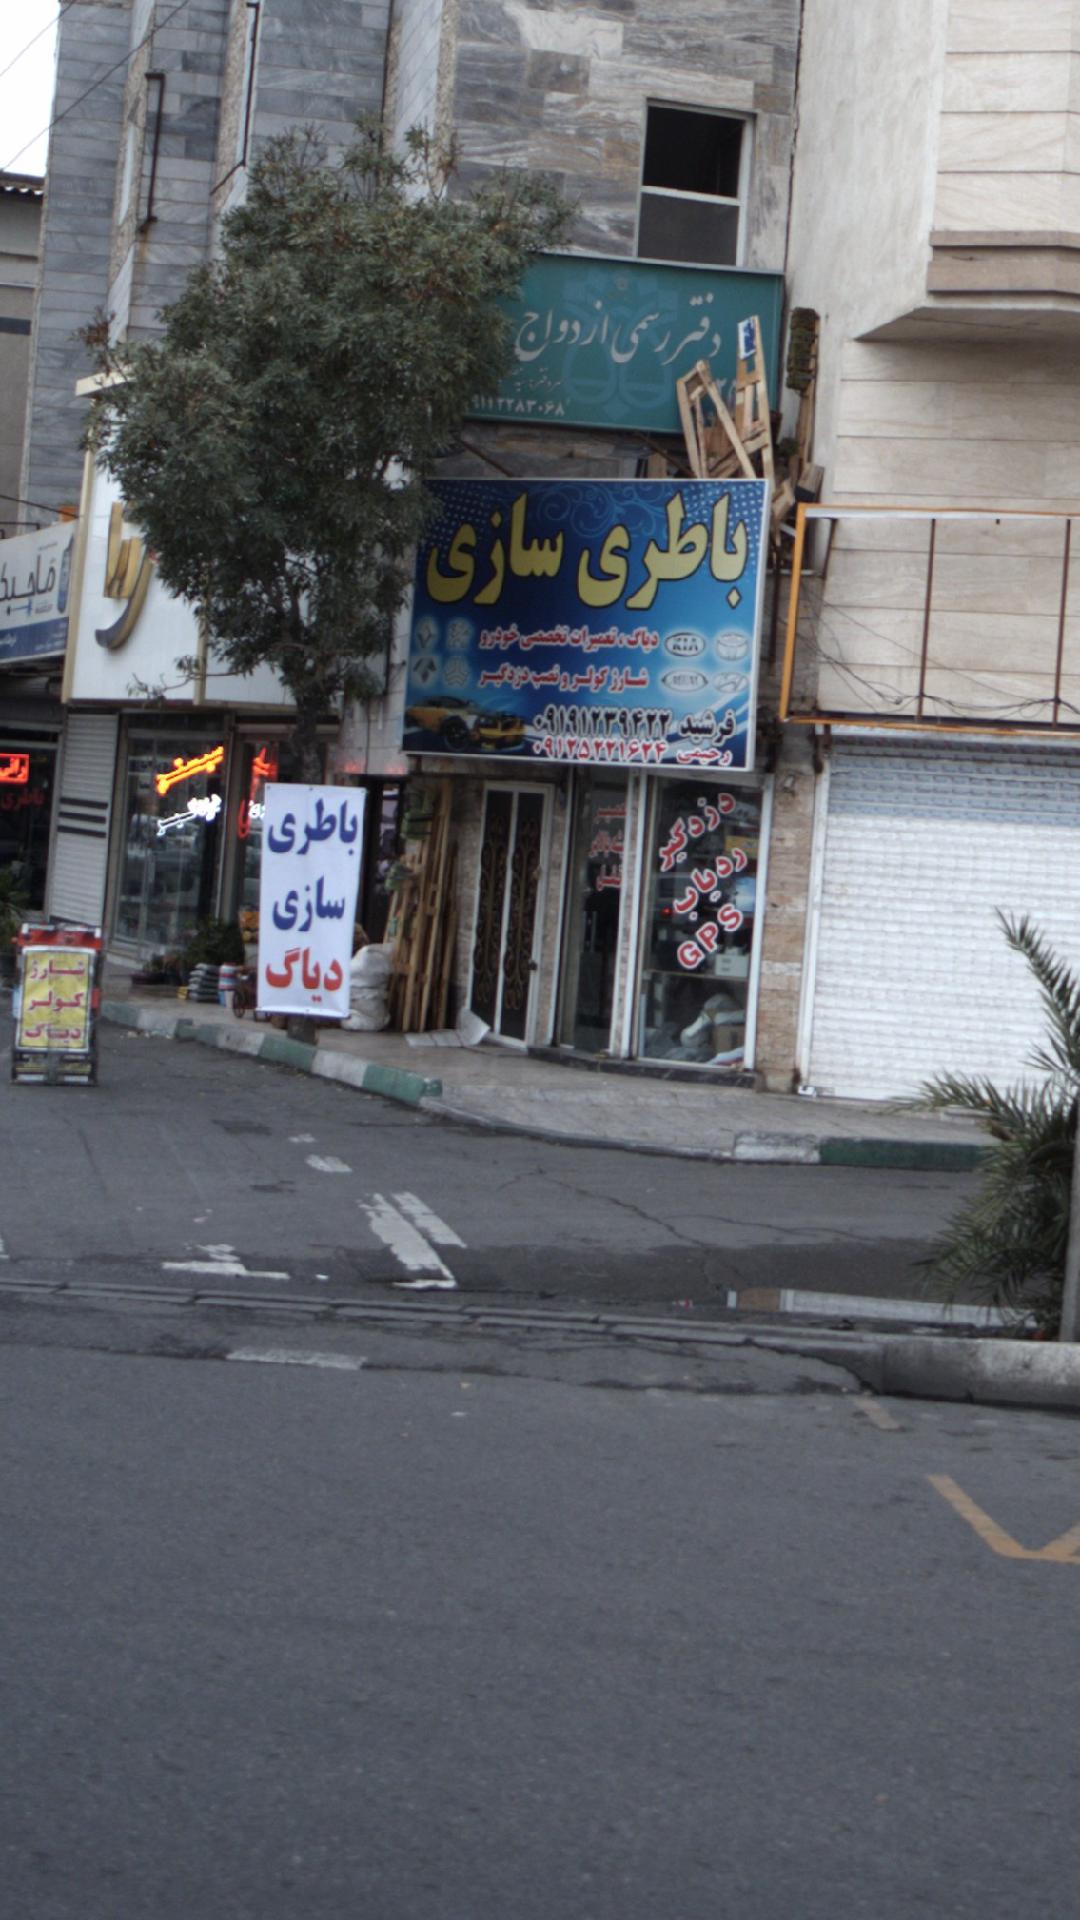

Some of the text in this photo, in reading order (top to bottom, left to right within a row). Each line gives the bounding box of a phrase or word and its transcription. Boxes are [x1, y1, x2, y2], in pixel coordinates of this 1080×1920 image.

[514, 292, 722, 366] دفتر رسمی ازدواج
[426, 490, 748, 611] باطری سازی
[570, 625, 618, 652] تعمیرات
[570, 664, 609, 692] کولر
[679, 709, 736, 746] فرشید
[267, 798, 358, 856] باطری
[659, 793, 735, 872] دزدگیر
[272, 873, 346, 932] سازی
[674, 848, 747, 921] ردیاب
[677, 904, 743, 968] GPS
[28, 991, 84, 1012] کولر
[265, 947, 344, 1003] دیاگ
